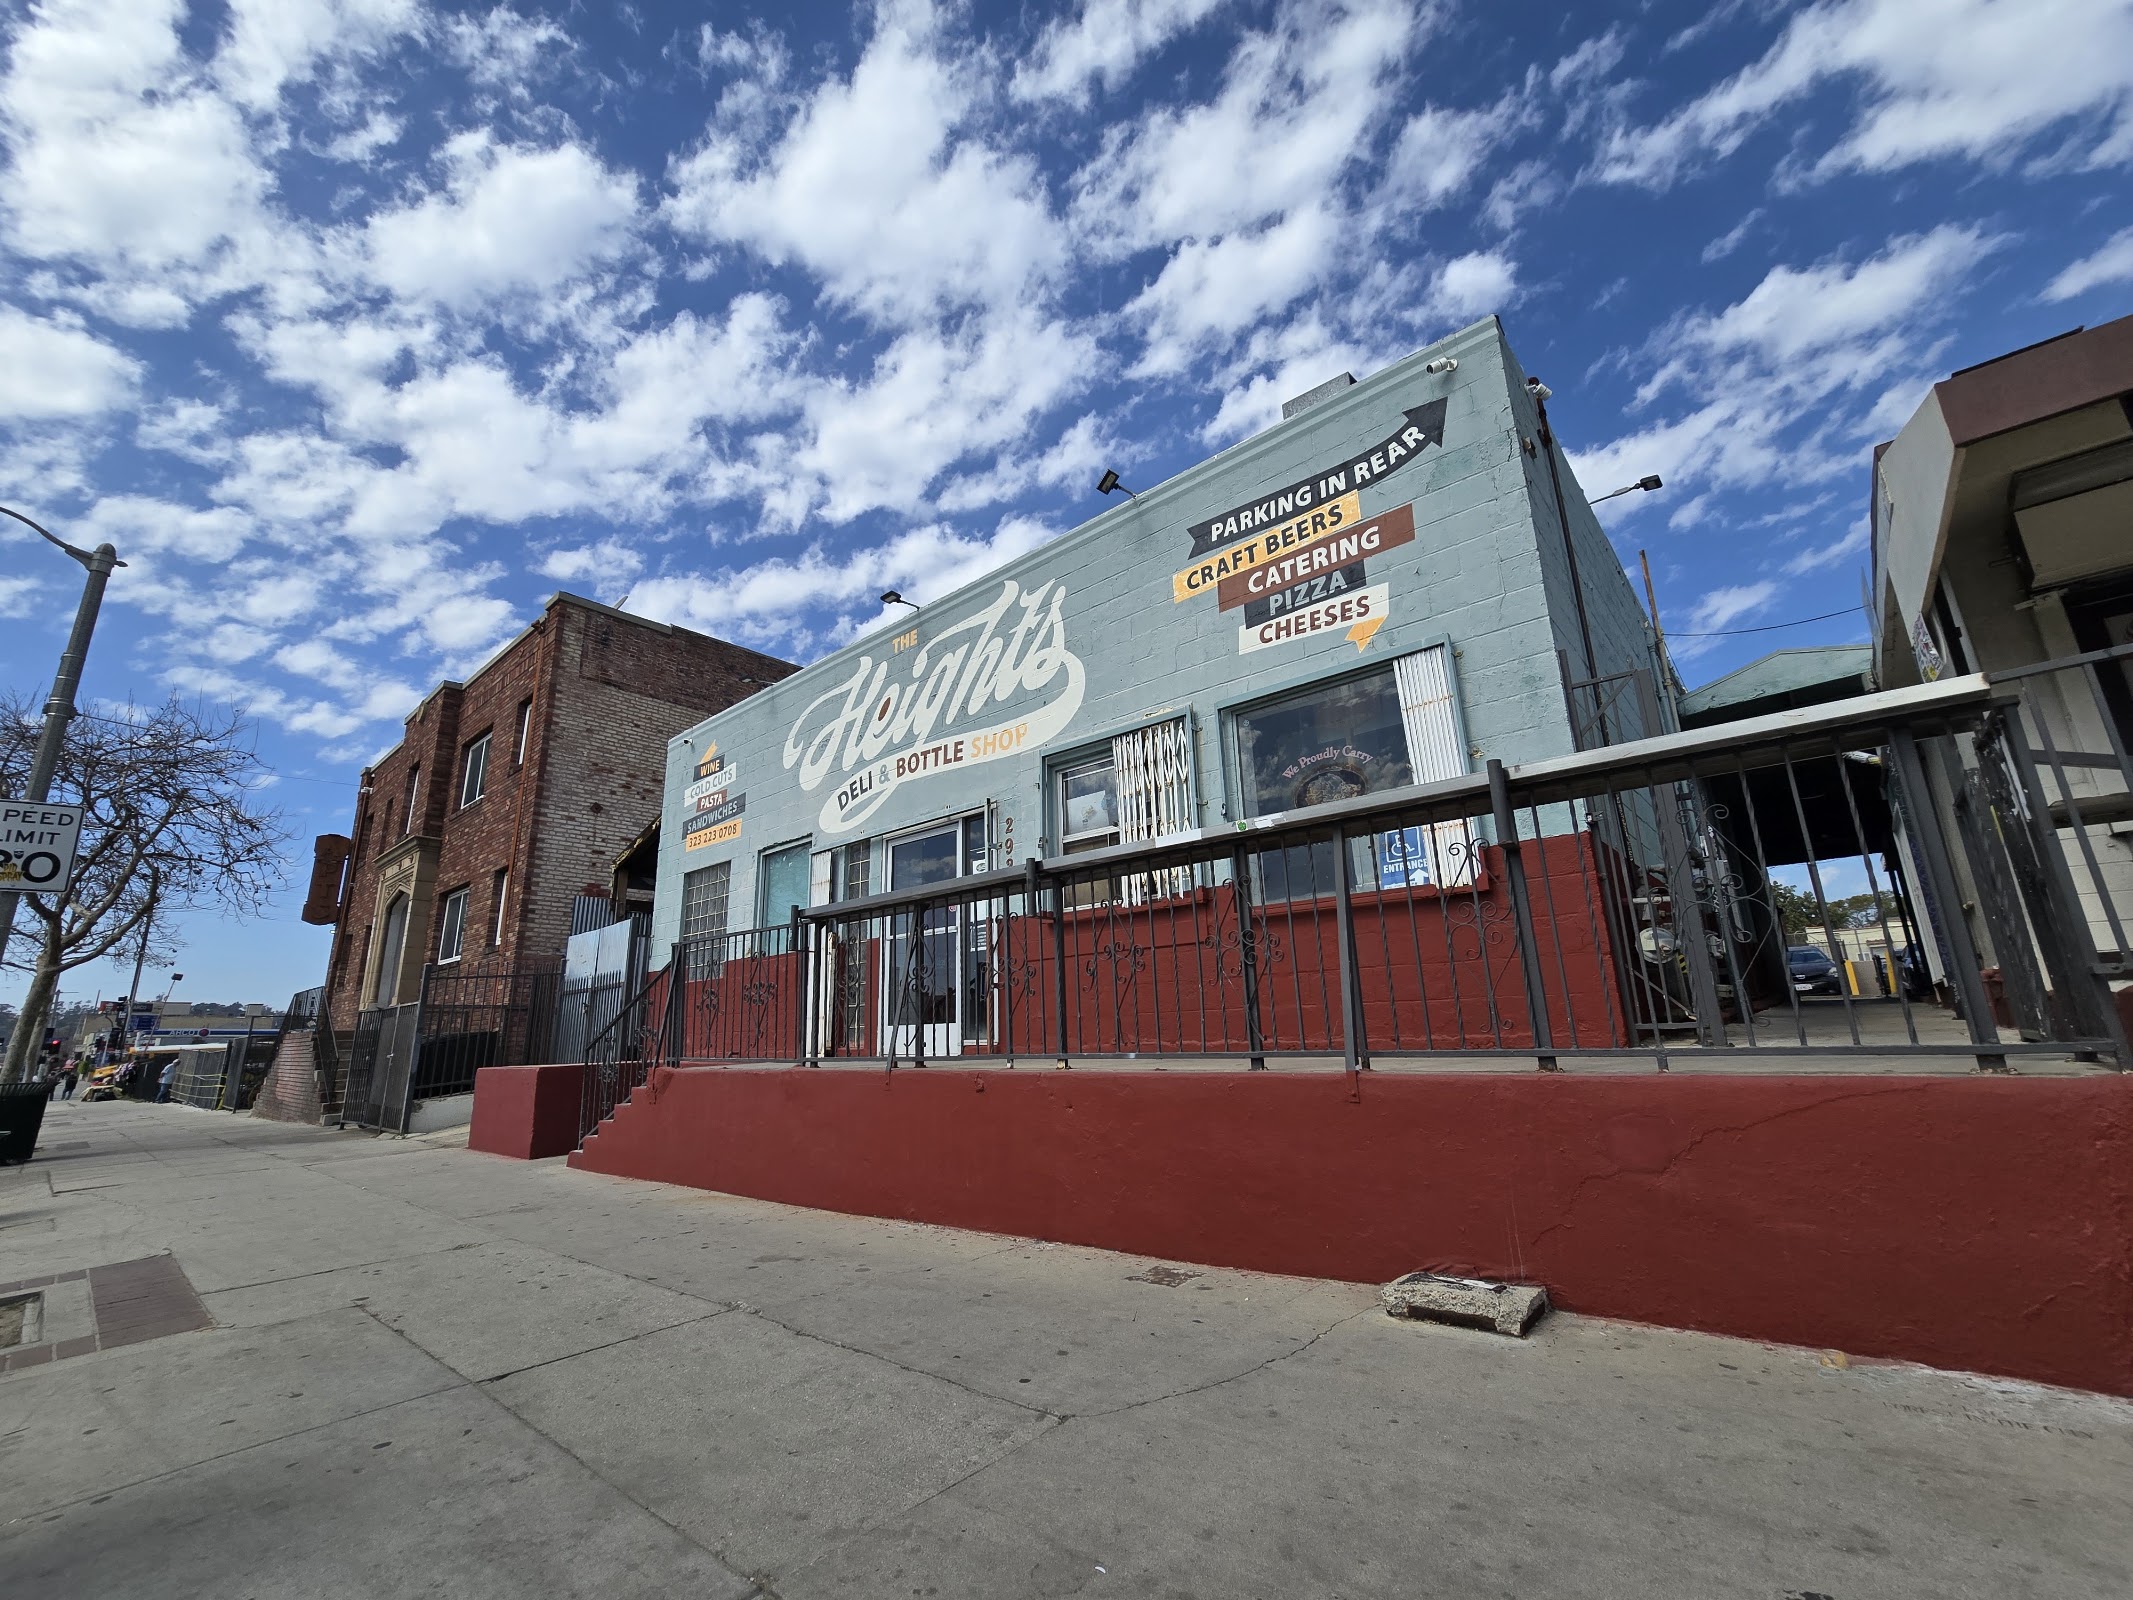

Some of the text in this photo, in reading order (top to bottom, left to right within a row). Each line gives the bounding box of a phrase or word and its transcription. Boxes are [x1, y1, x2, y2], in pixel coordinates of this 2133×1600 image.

[1210, 426, 1426, 543] PARKING IN REAR
[1186, 504, 1344, 590] CRAFT BEERS
[1247, 526, 1380, 594] CATERING
[1269, 569, 1348, 616] PIZZA
[1259, 595, 1371, 644] CHEESES
[892, 629, 918, 654] THE
[783, 579, 1072, 790] Heights
[700, 760, 720, 777] WINE
[837, 723, 1028, 811] DELI & BOTTLE SHOP
[1282, 745, 1374, 779] We Proudly Carry
[690, 768, 733, 799] COLD CUTS
[2, 809, 75, 826] PEED
[687, 801, 738, 834] SANDWICHES
[700, 793, 723, 809] PASTA
[0, 829, 61, 845] IMIT
[689, 823, 737, 848] 323 223 0708
[1383, 859, 1428, 874] ENTRANCE
